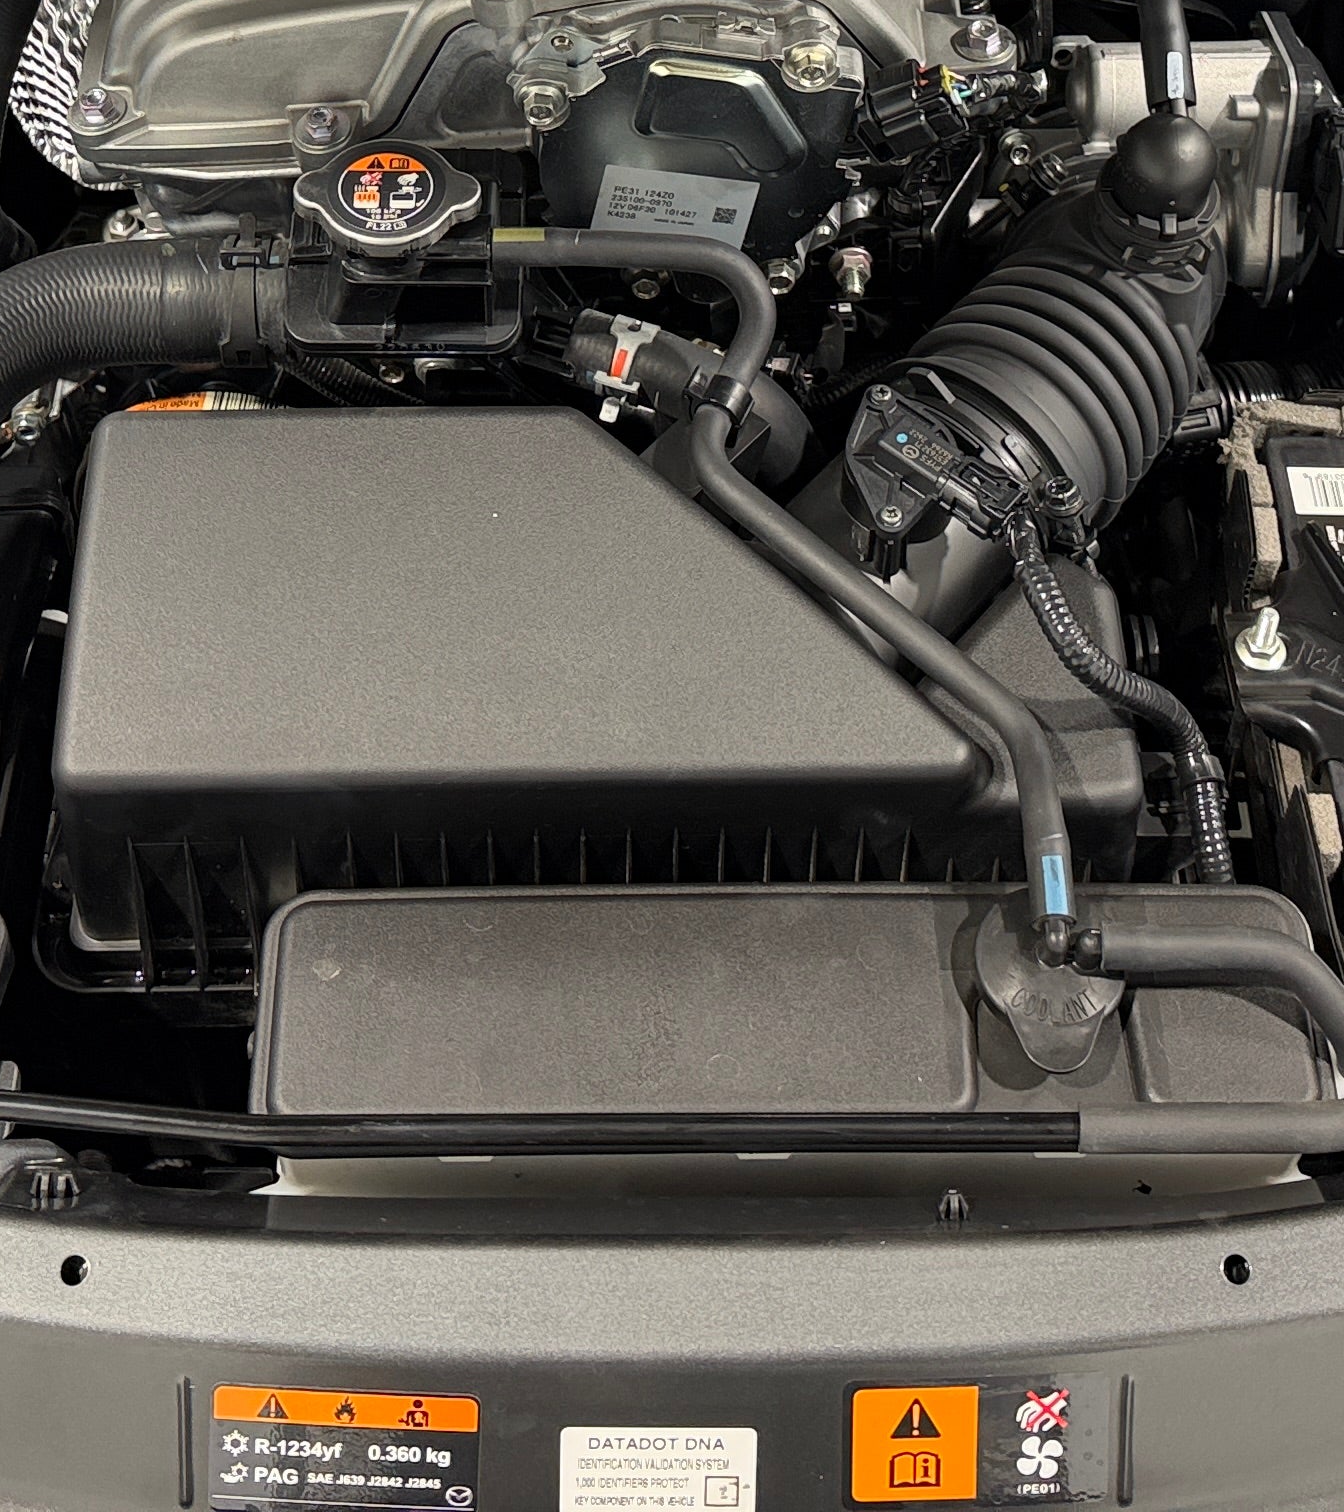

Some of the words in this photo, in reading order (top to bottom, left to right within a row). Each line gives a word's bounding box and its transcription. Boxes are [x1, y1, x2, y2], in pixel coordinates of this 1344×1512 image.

[366, 222, 392, 230] FL22
[1011, 988, 1098, 1024] COOLANT
[588, 1437, 679, 1450] DATADOT
[685, 1438, 725, 1450] DNA
[254, 1438, 344, 1461] R-1234yf
[367, 1444, 422, 1463] 0.360
[426, 1447, 452, 1467] kg
[577, 1458, 643, 1470] IDENTIFICATION
[645, 1459, 693, 1470] VALIDATION
[695, 1459, 730, 1470] SYSTEM
[254, 1467, 299, 1485] PAG
[307, 1473, 334, 1485] SAE
[336, 1474, 365, 1486] J639
[367, 1475, 403, 1488] J2842
[405, 1476, 441, 1489] J2845
[598, 1477, 649, 1488] IDENTIFIERS
[651, 1477, 689, 1488] PROTECT
[1017, 1483, 1061, 1495] (PE01)
